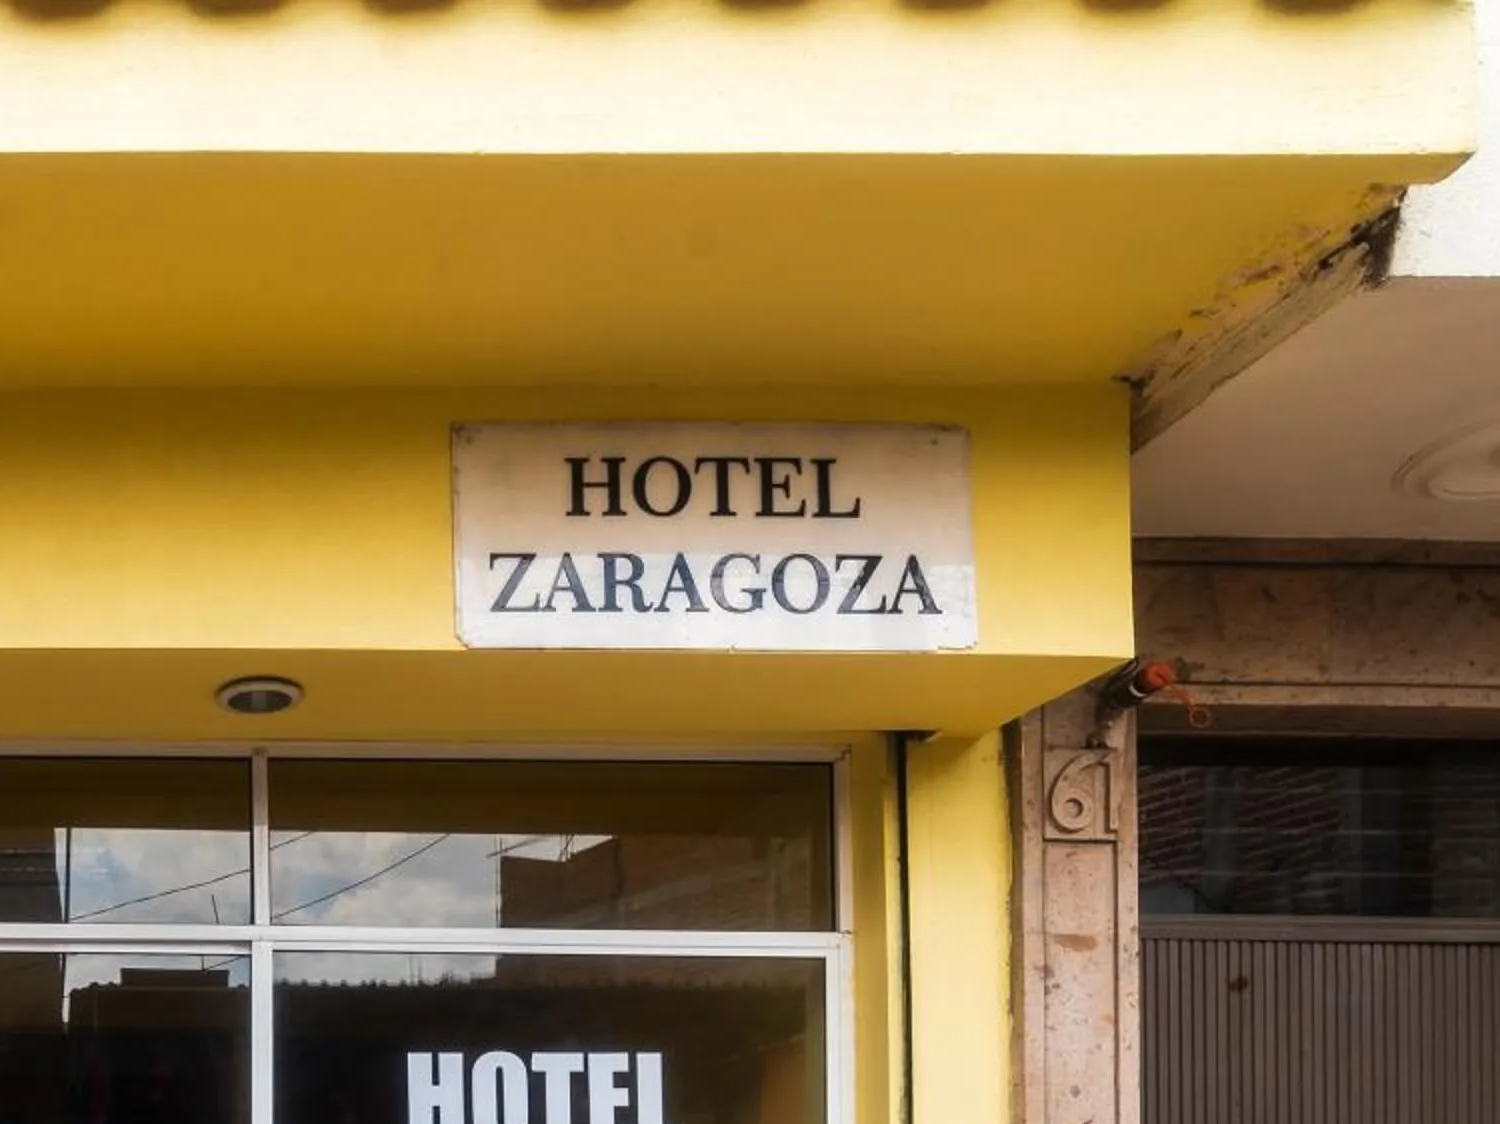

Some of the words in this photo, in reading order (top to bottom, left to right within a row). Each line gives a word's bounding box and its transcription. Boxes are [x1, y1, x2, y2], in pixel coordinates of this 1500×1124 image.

[564, 457, 861, 518] HOTEL
[488, 552, 943, 615] ZARAGOZA
[1048, 750, 1119, 834] 61
